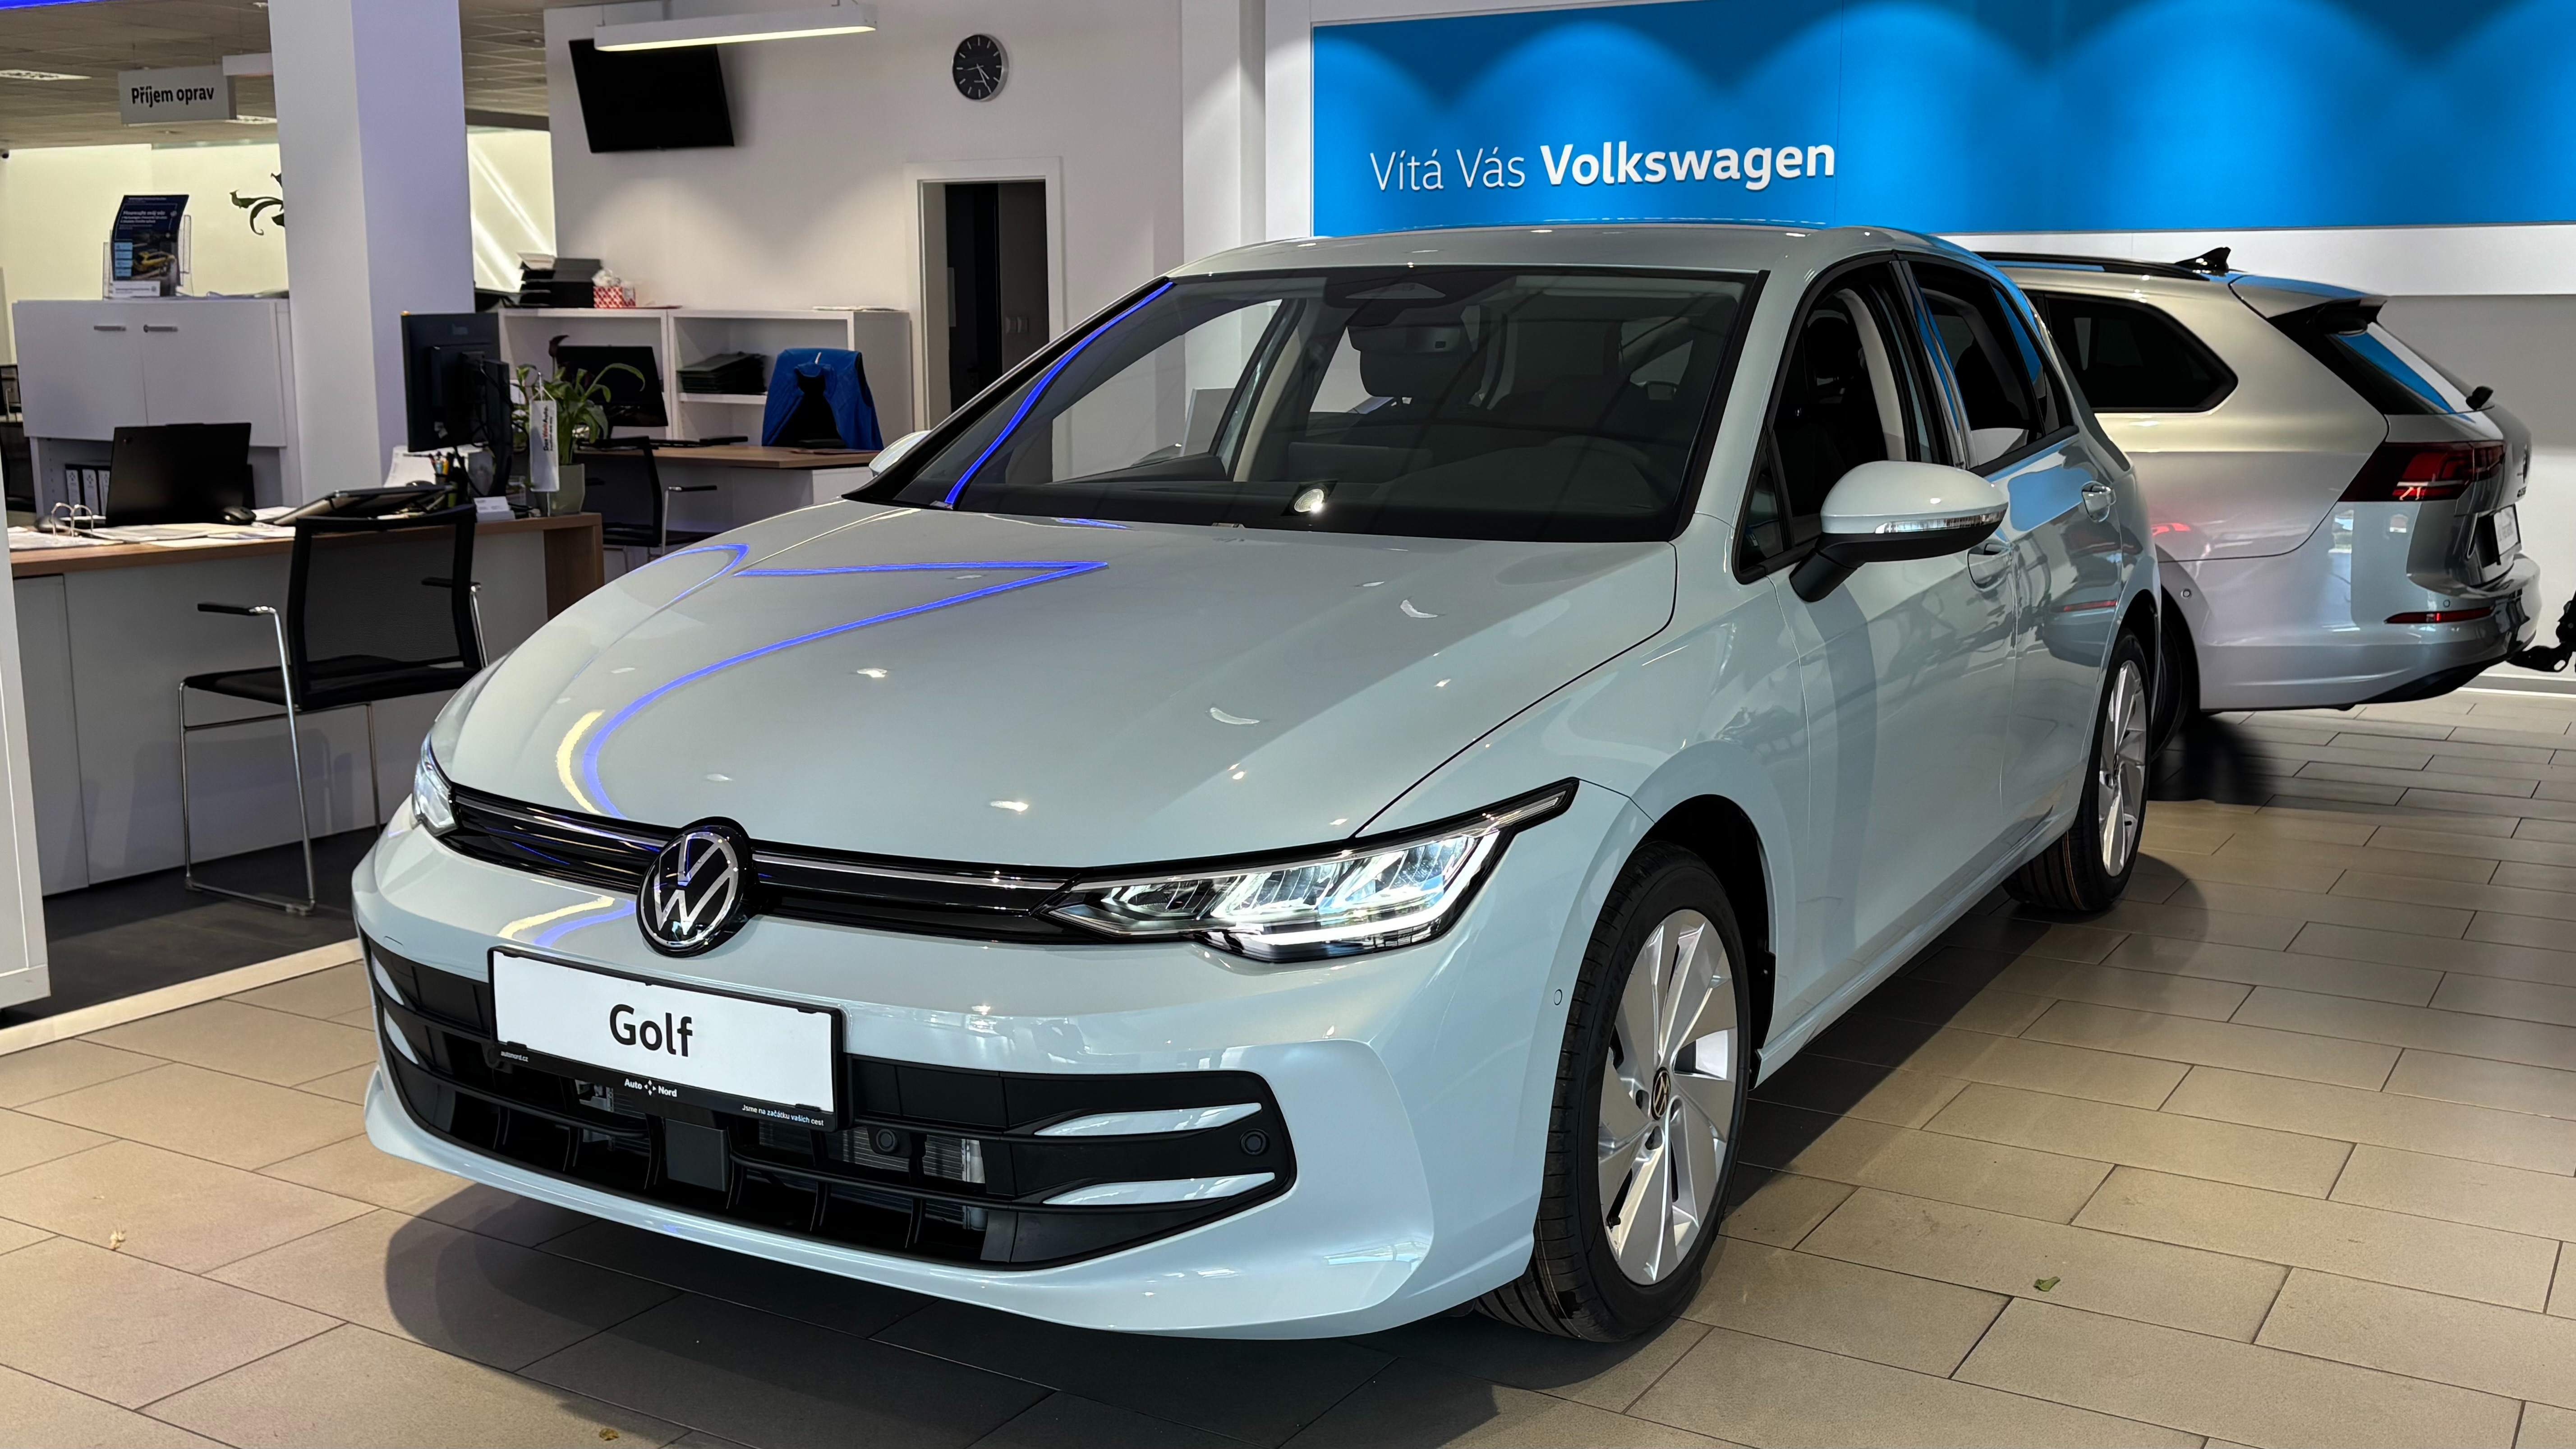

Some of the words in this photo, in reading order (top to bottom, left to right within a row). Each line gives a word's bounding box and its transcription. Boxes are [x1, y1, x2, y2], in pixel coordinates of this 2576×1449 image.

[131, 86, 173, 108] Příjem
[176, 87, 214, 106] oprav
[1370, 148, 1444, 191] Vítá
[1456, 147, 1526, 188] Vás
[1540, 141, 1835, 190] Volkswagen
[610, 1004, 693, 1057] Golf
[624, 1078, 642, 1090] Auto
[658, 1086, 677, 1097] Nord
[742, 1104, 758, 1113] Jsme
[767, 1110, 790, 1119] začátku
[791, 1115, 810, 1123] vašich
